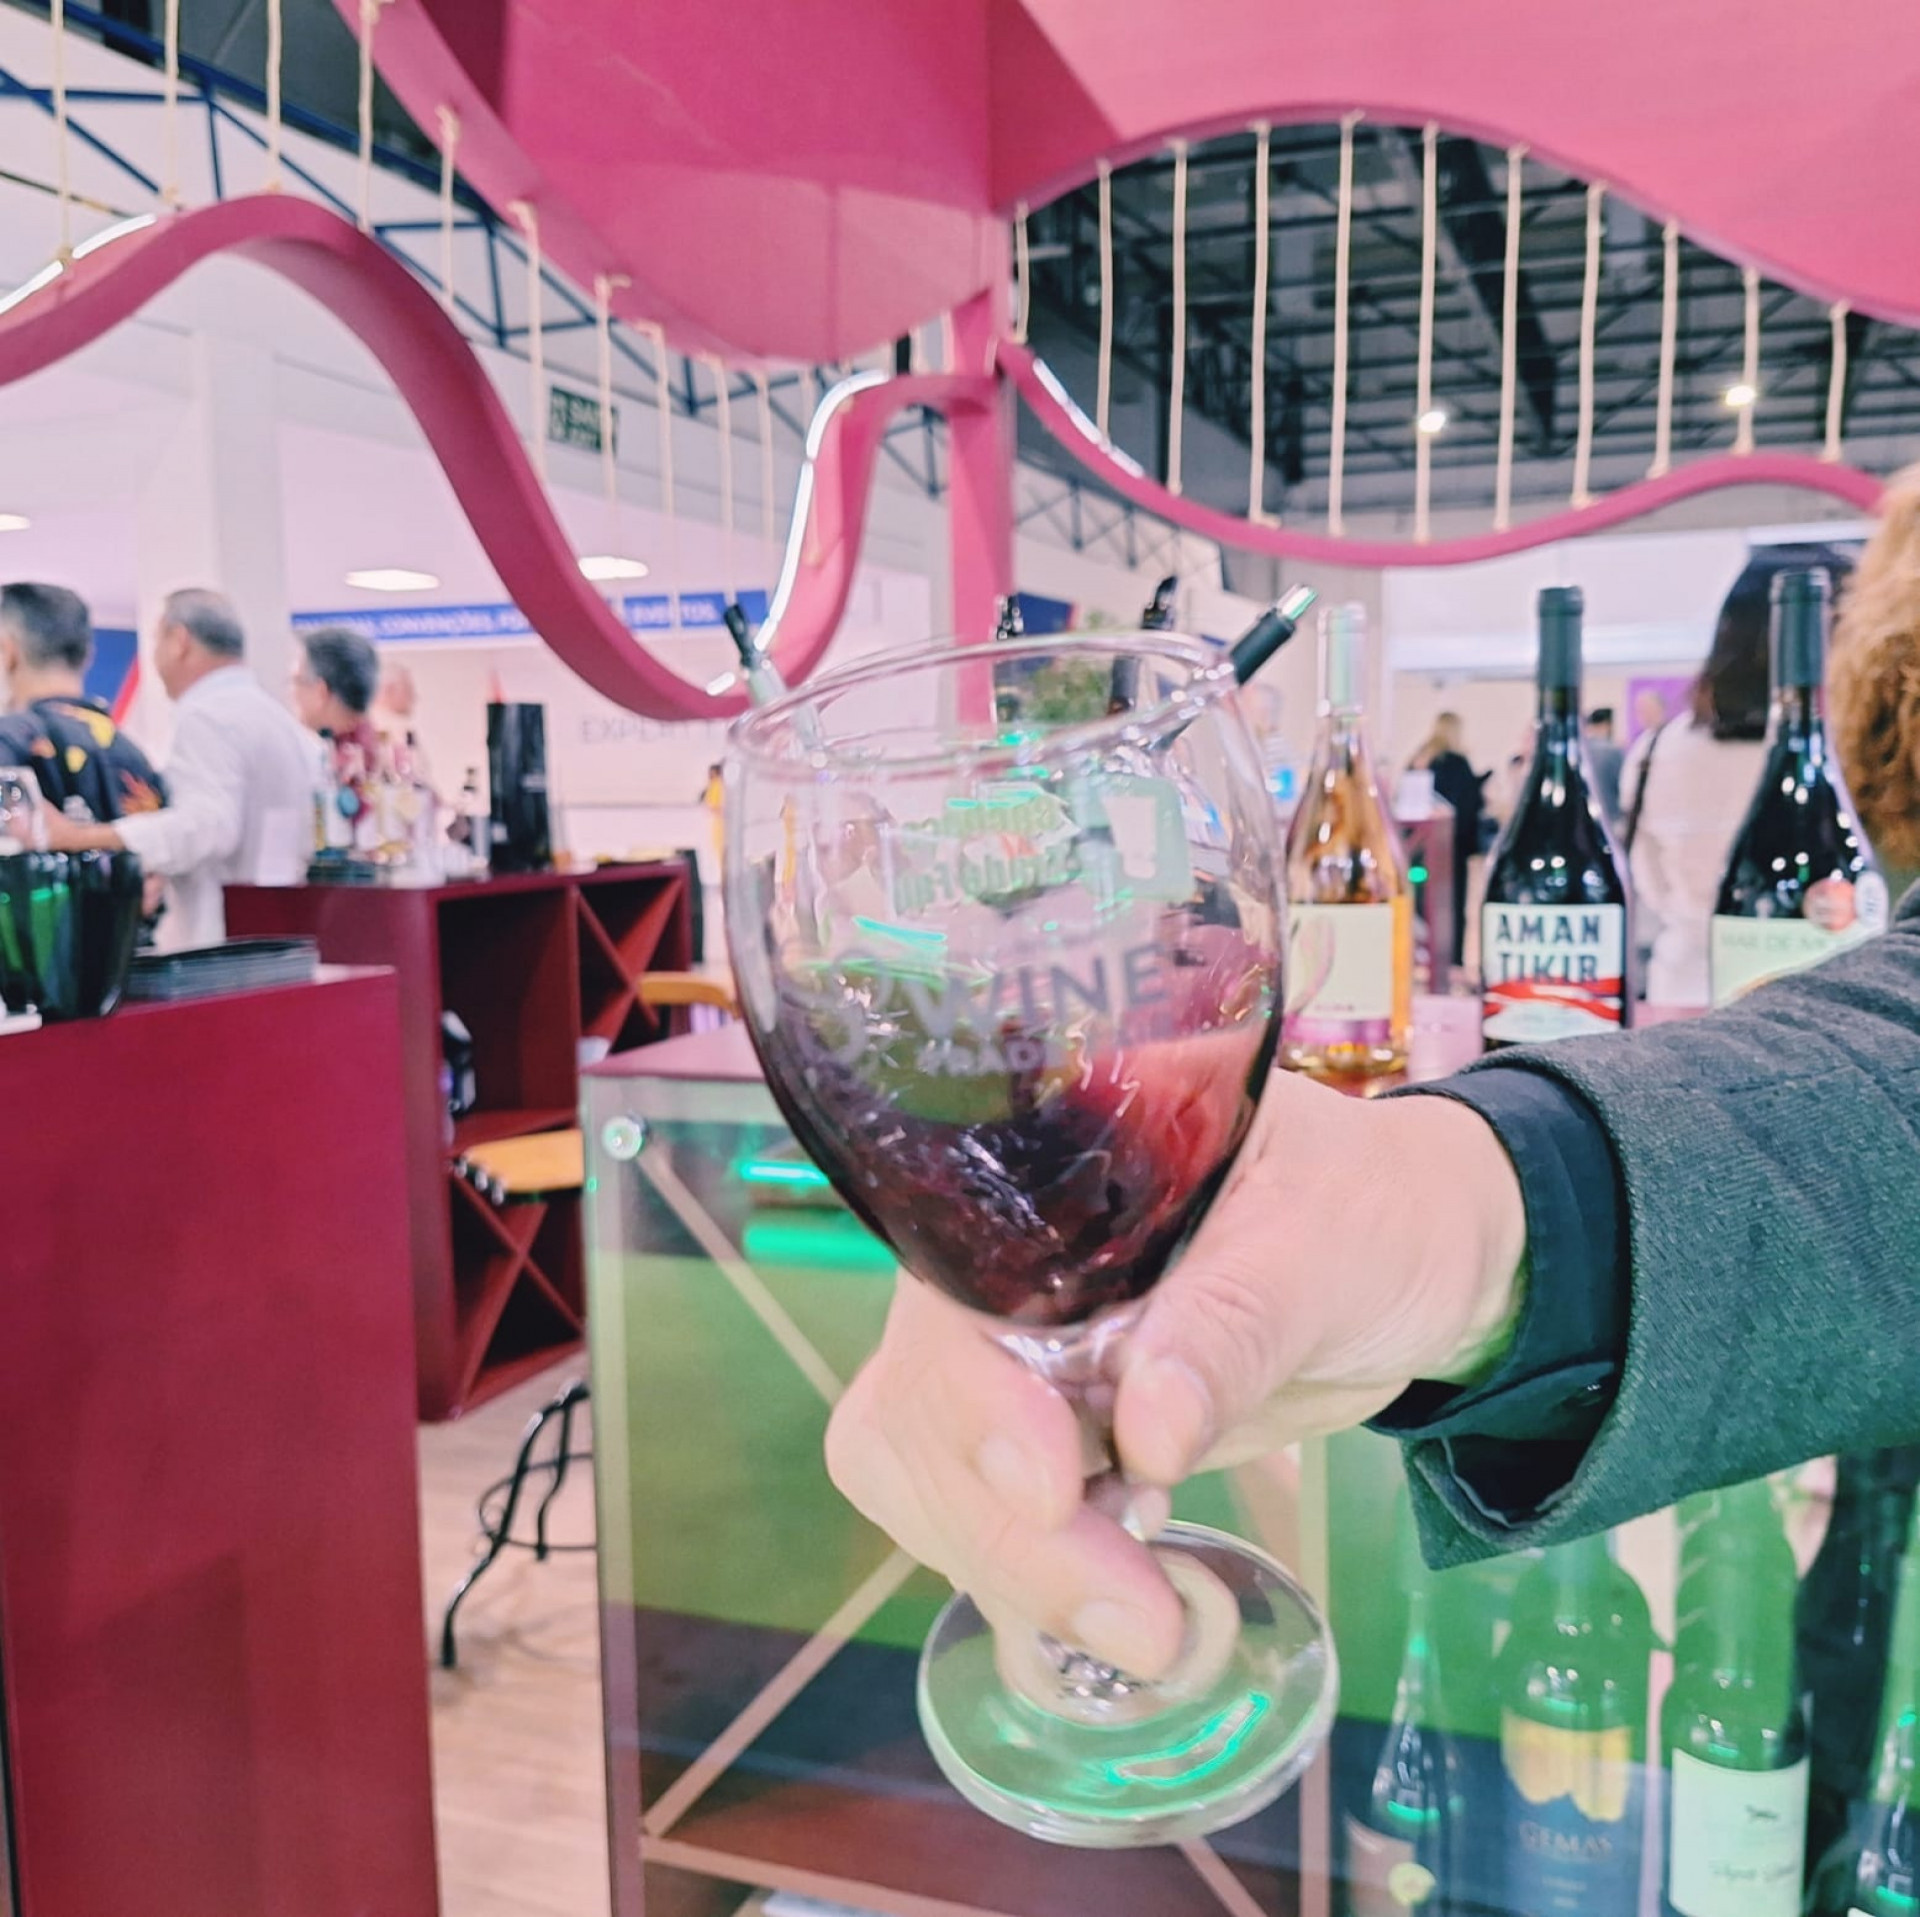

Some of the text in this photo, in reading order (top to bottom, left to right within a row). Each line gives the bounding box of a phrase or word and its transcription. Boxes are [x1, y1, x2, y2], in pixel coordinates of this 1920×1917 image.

[1496, 914, 1600, 943] AMAN
[1498, 953, 1597, 984] TIKIR
[900, 943, 1166, 1040] WINE
